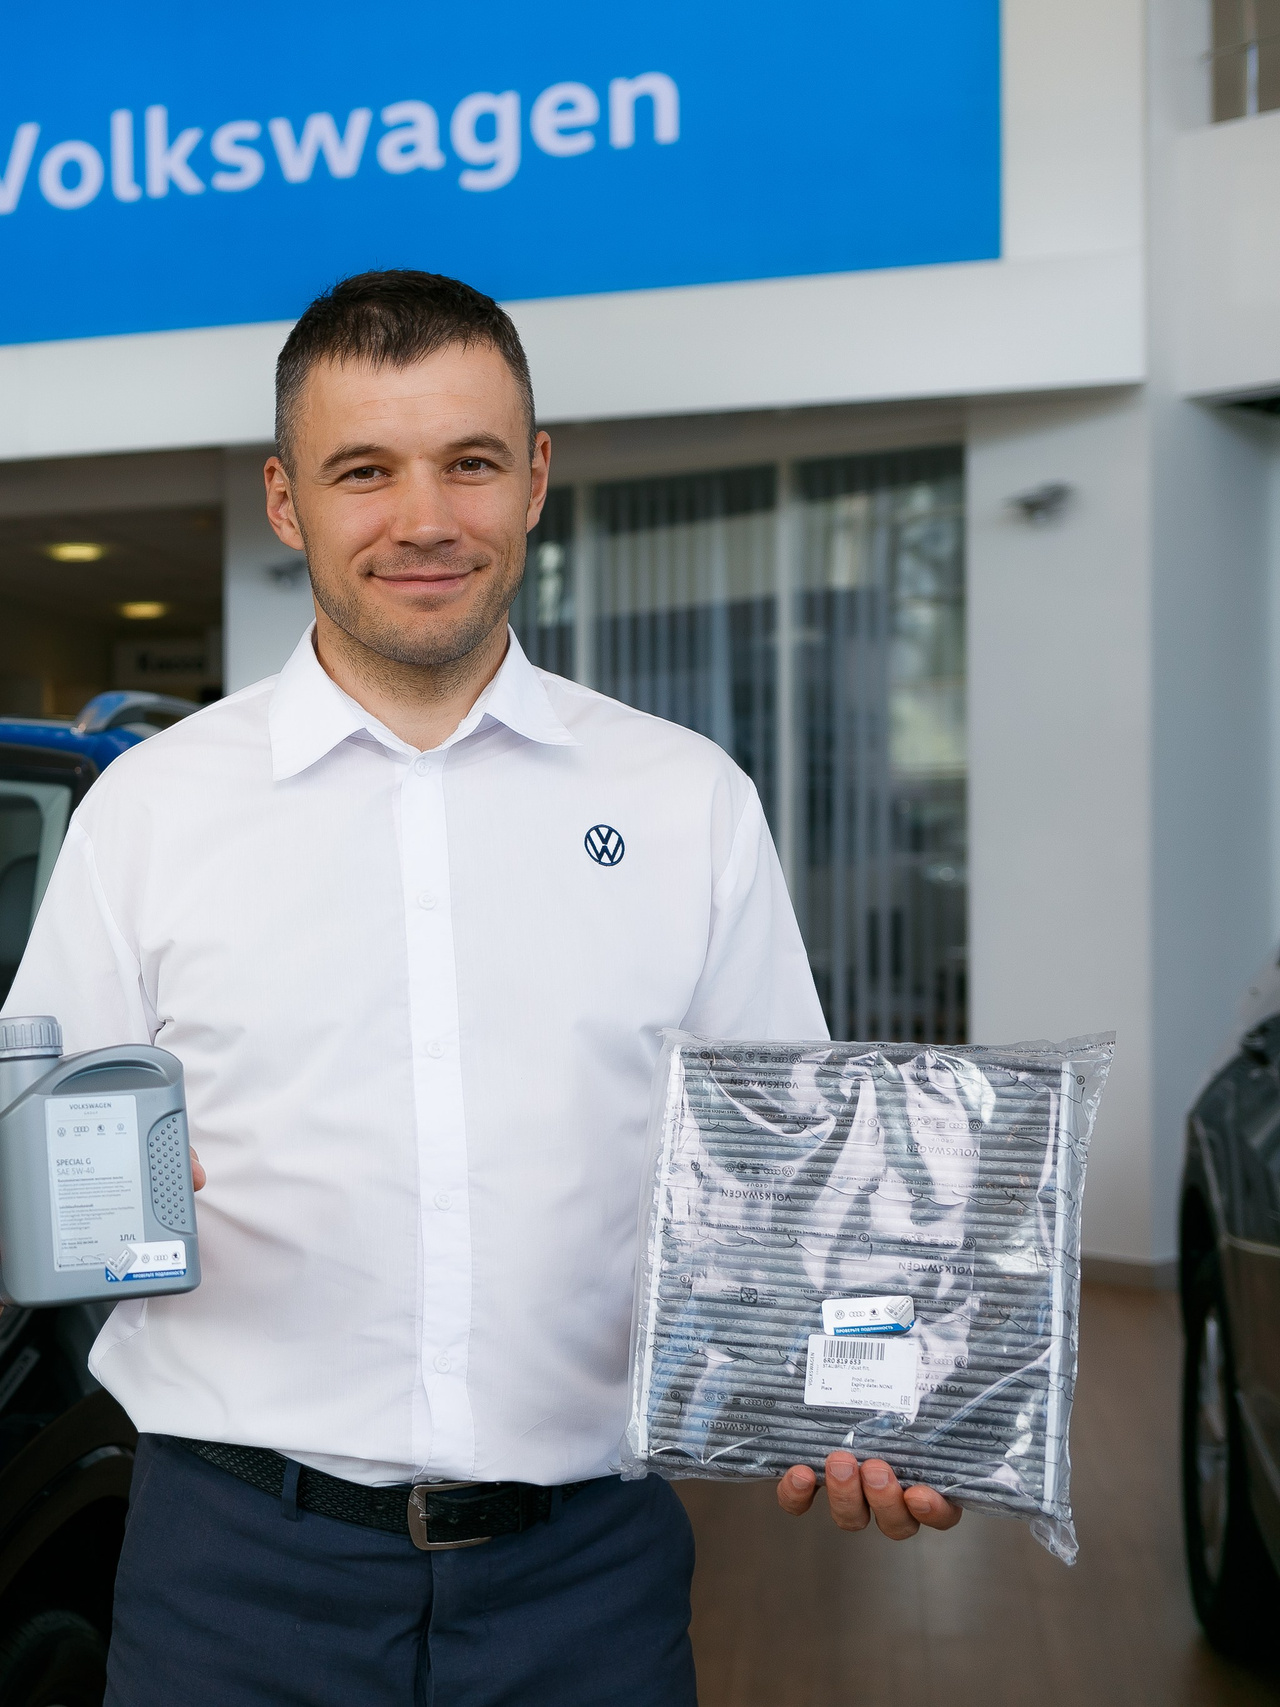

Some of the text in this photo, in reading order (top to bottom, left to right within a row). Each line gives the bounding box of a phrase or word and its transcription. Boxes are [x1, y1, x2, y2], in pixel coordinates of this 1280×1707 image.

[729, 1077, 800, 1090] VOLKSWAGEN
[69, 1102, 112, 1110] VOLKSWAGEN
[905, 1143, 980, 1158] VOLKSWAGEN
[56, 1158, 84, 1167] SPECIAL
[56, 1167, 96, 1176] SAE 5W-40
[720, 1188, 793, 1203] VOLKSWAGEN
[897, 1260, 974, 1275] VOLKSWAGEN
[700, 1420, 771, 1434] VOLKSWAGEN
